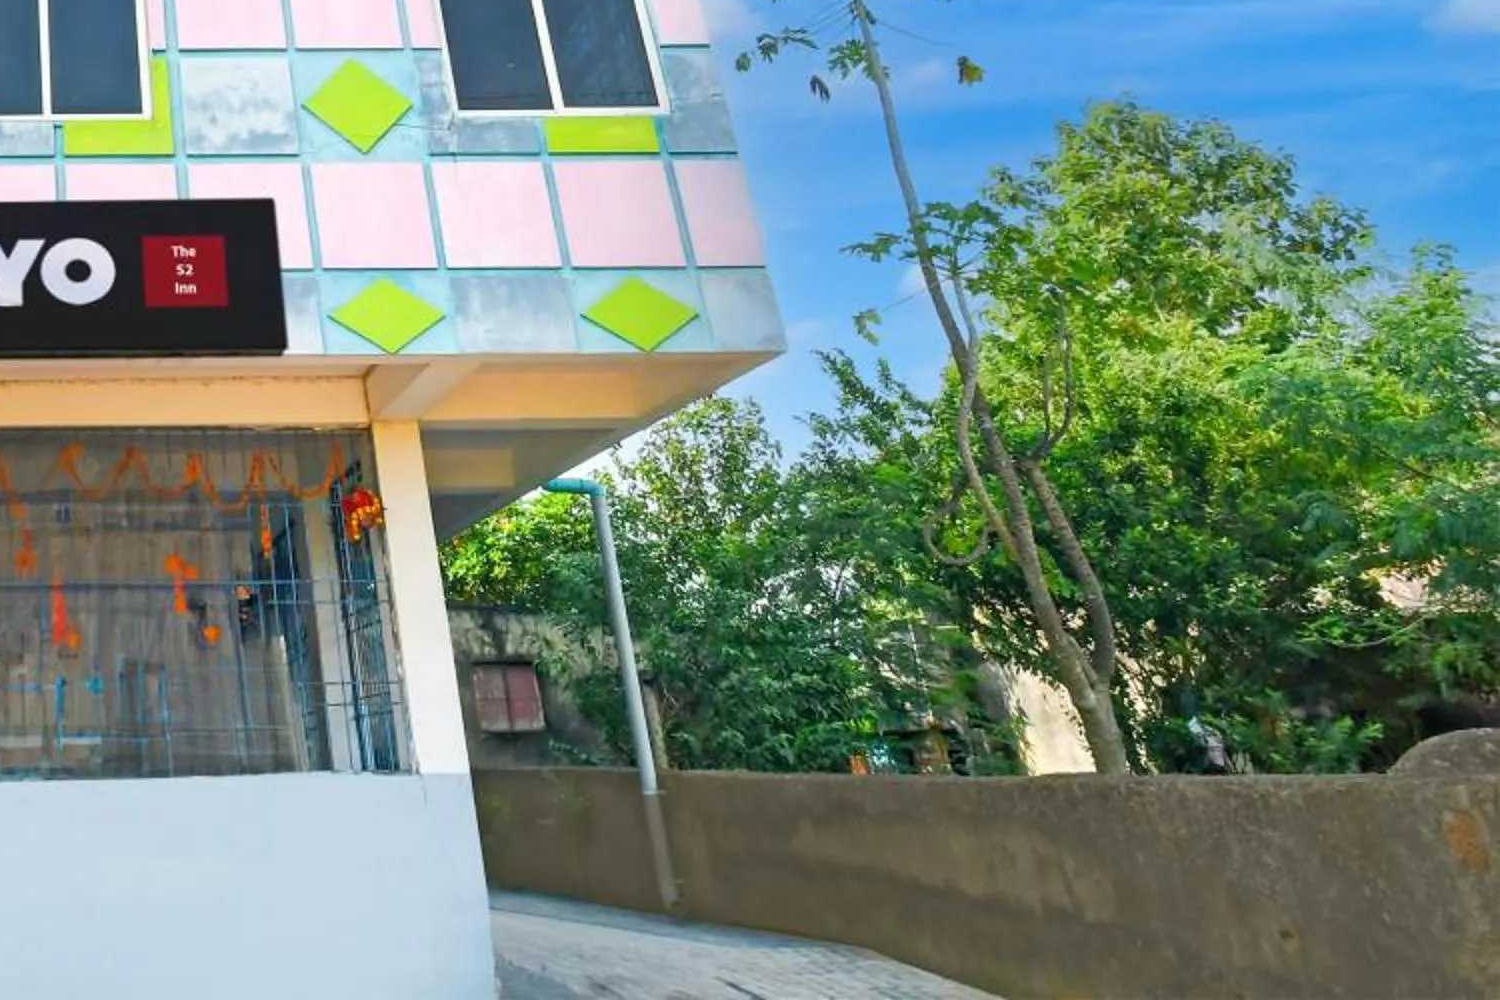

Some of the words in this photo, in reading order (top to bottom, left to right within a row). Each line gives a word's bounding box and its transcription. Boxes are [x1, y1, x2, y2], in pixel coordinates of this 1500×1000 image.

[171, 245, 197, 258] The
[175, 263, 195, 276] S2
[174, 281, 197, 295] Inn
